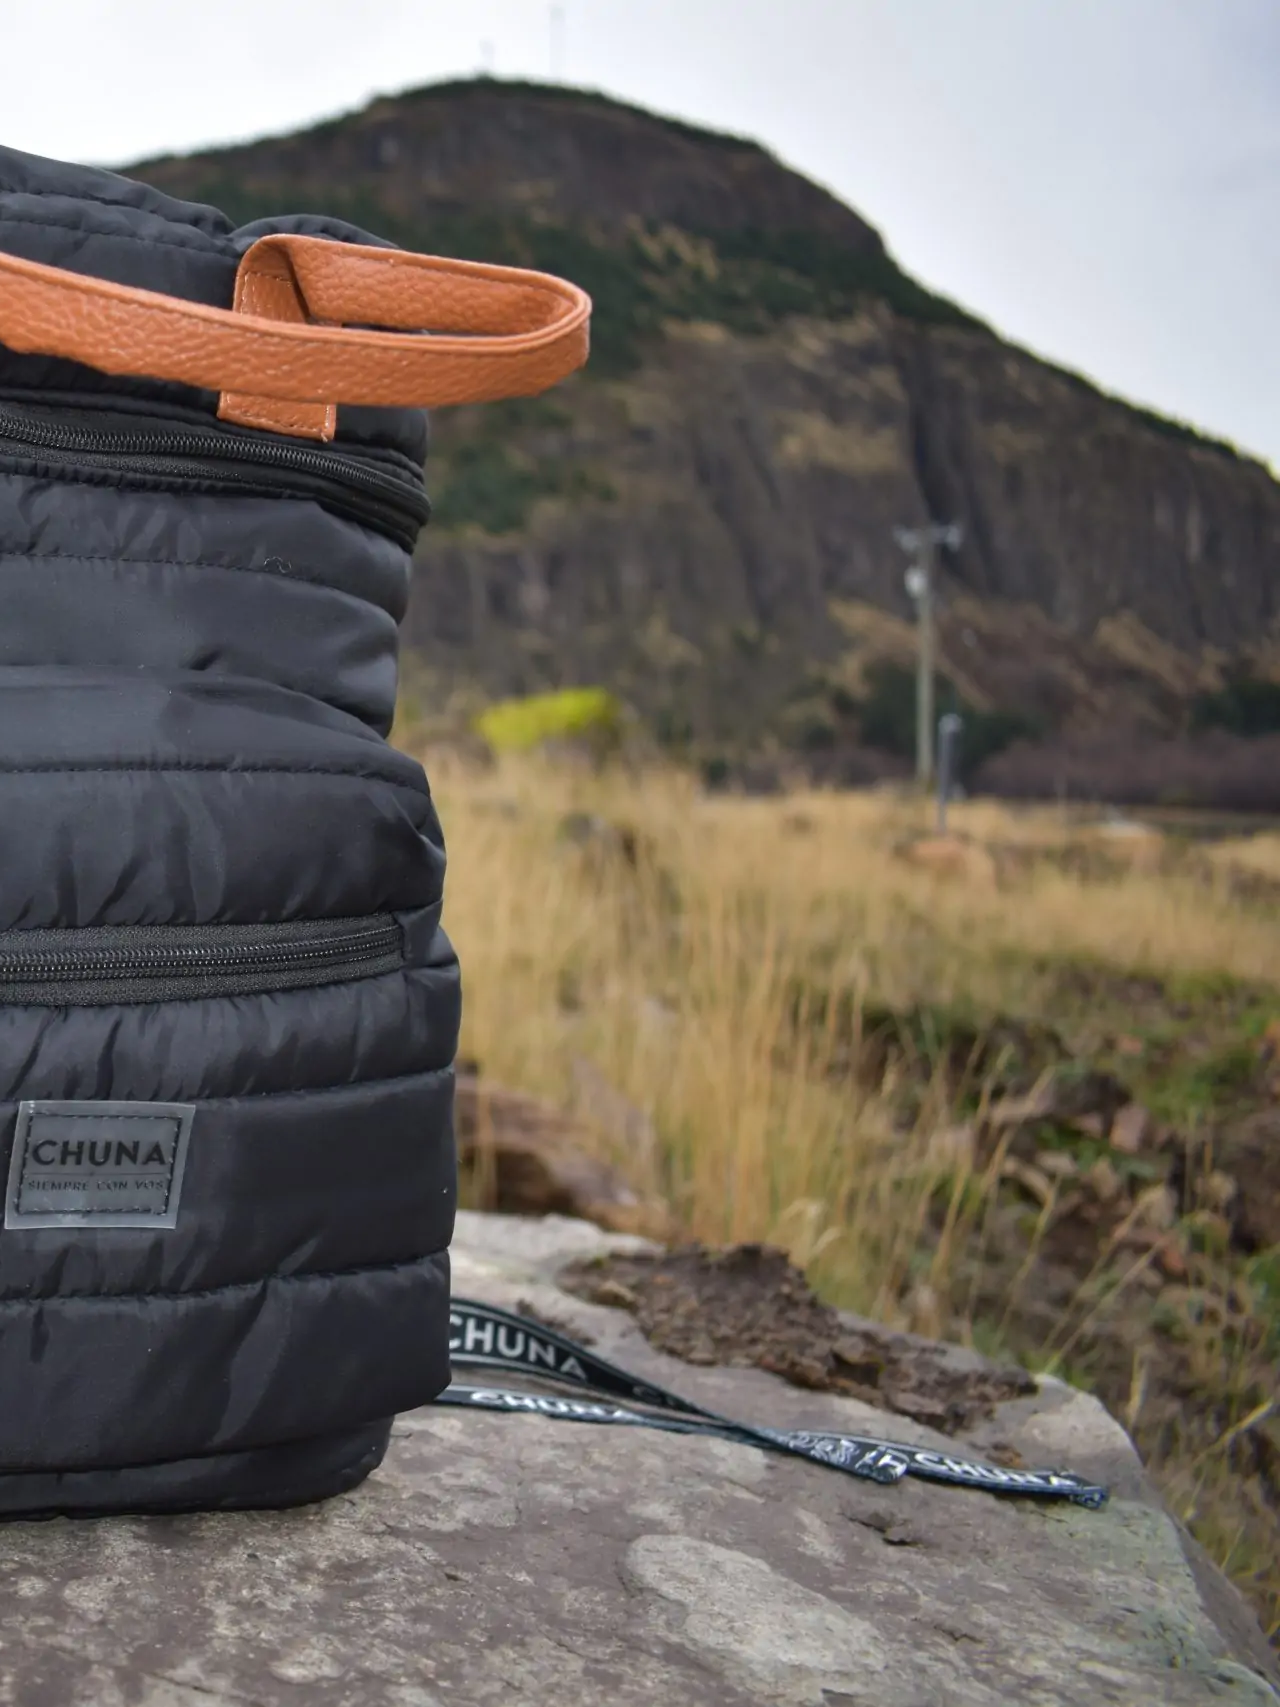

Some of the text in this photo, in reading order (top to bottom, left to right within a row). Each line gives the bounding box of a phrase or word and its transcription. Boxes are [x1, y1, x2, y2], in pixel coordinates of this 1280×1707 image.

[31, 1140, 167, 1167] CHUNA
[27, 1179, 165, 1191] SIEMPRE CON VOS
